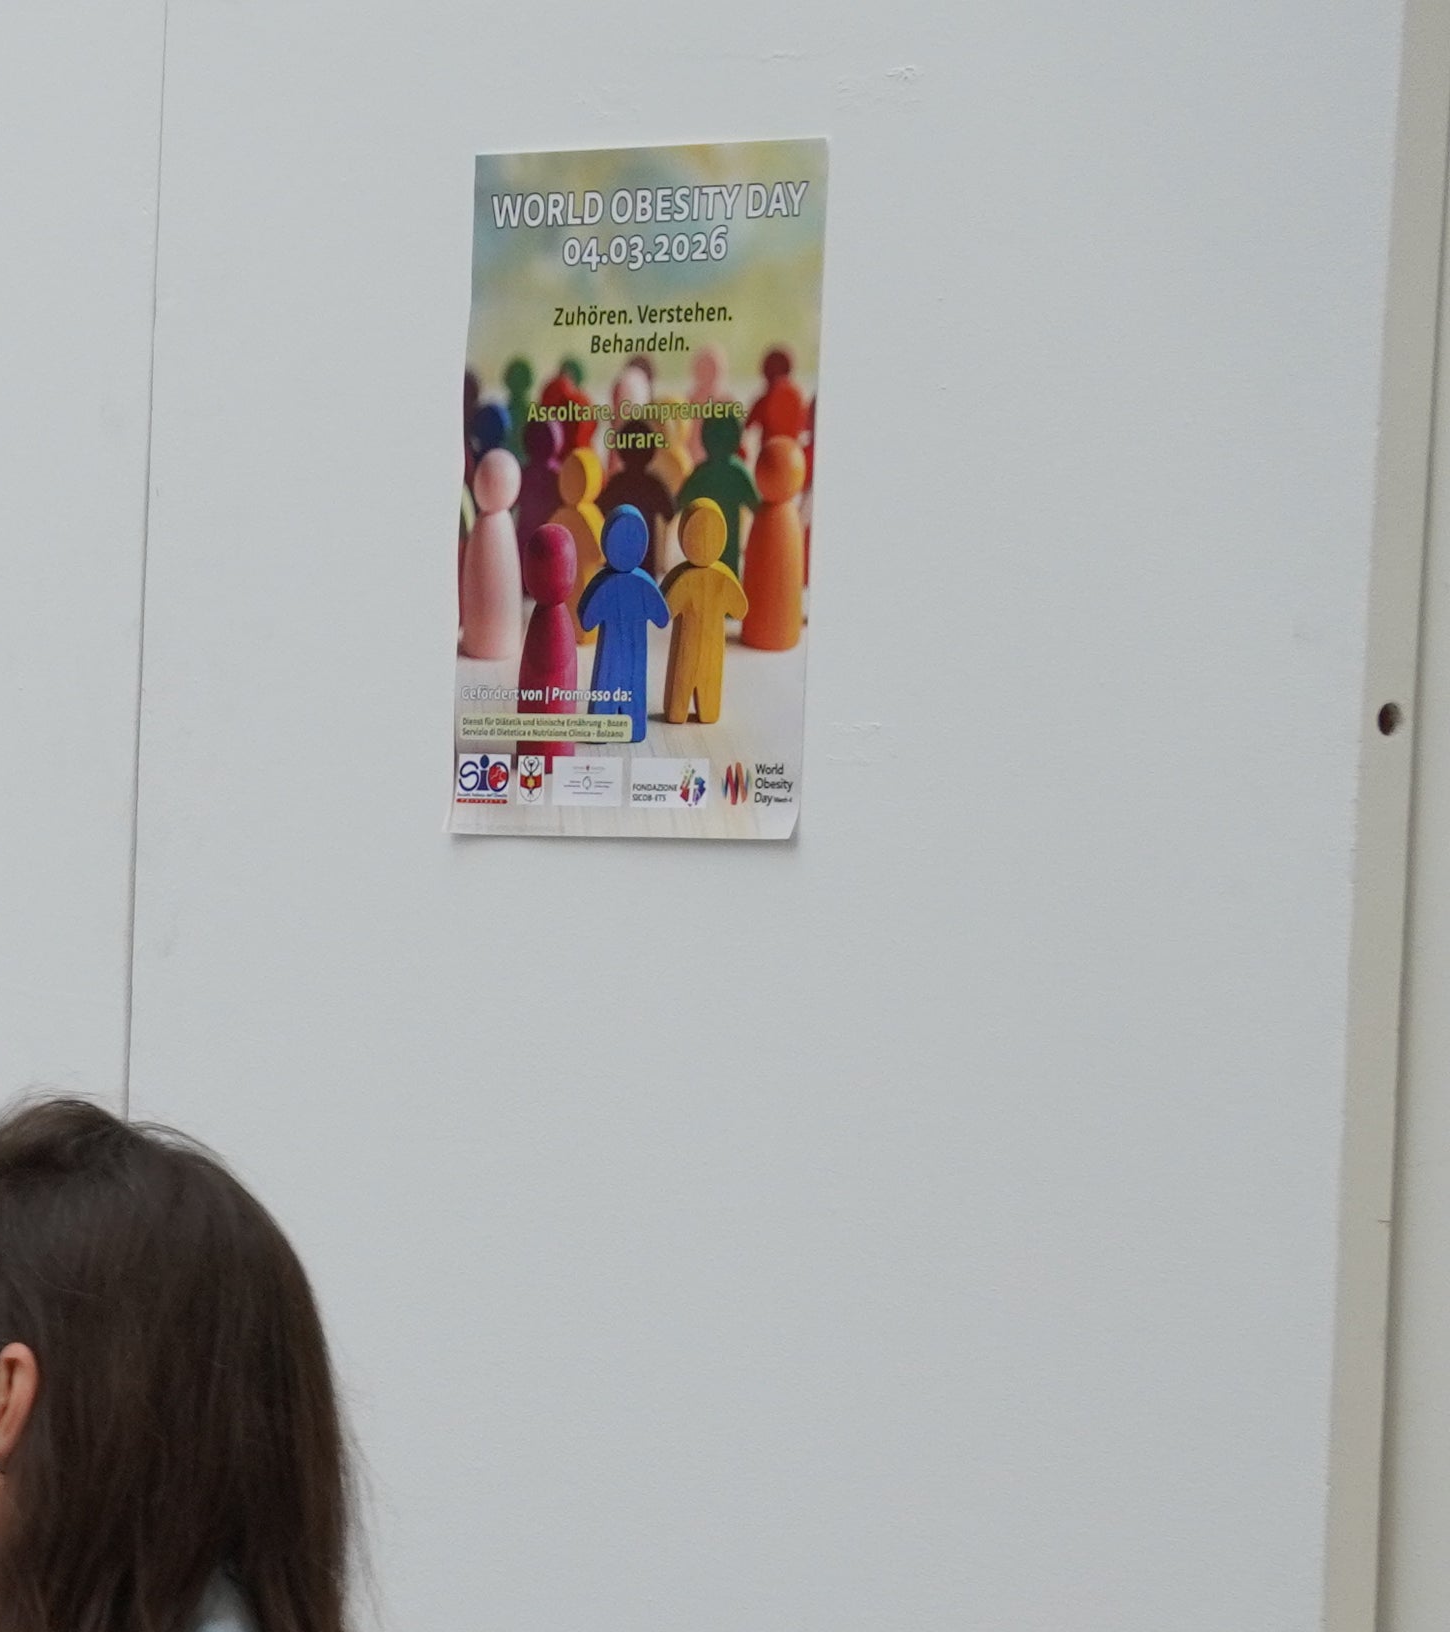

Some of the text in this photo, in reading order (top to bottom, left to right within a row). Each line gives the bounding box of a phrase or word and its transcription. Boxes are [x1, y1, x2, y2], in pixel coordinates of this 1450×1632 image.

[491, 181, 809, 228] WORLD OBESITY DAY
[562, 225, 728, 272] 04.03.2026
[553, 301, 733, 327] Zuhören. Verstehen.
[590, 331, 690, 354] Behandeln.
[527, 397, 748, 424] Ascoltare. Comprendere.
[604, 429, 670, 450] Curare.
[461, 685, 519, 701] Gefördert
[521, 690, 543, 701] von
[552, 687, 611, 701] Promosso
[613, 687, 632, 702] da:
[755, 763, 784, 775] World
[632, 783, 678, 792] FONDAZIONE
[755, 777, 794, 793] Obesity
[754, 791, 773, 807] Day
